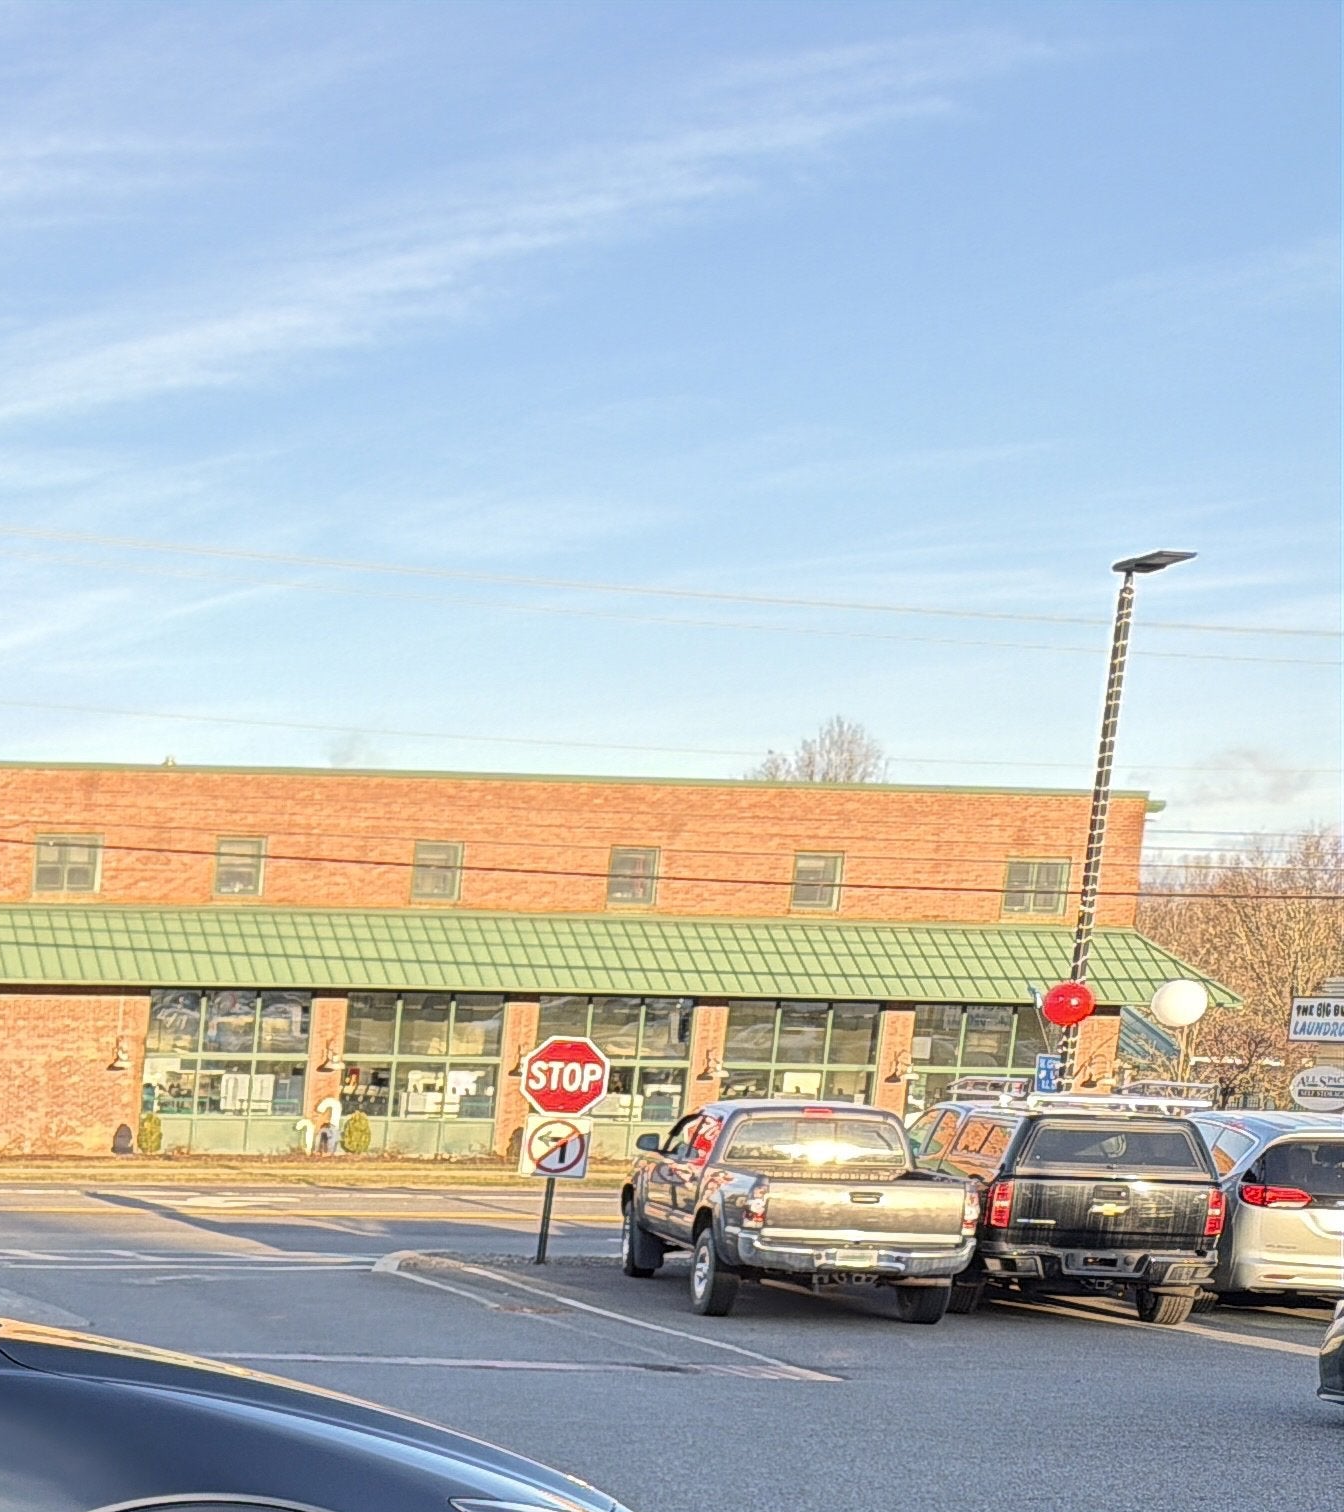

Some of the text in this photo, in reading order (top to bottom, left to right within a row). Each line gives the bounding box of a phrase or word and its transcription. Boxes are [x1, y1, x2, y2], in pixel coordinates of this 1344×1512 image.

[1296, 1004, 1315, 1017] THE
[1316, 1001, 1332, 1018] BIG
[528, 1060, 603, 1093] STOP
